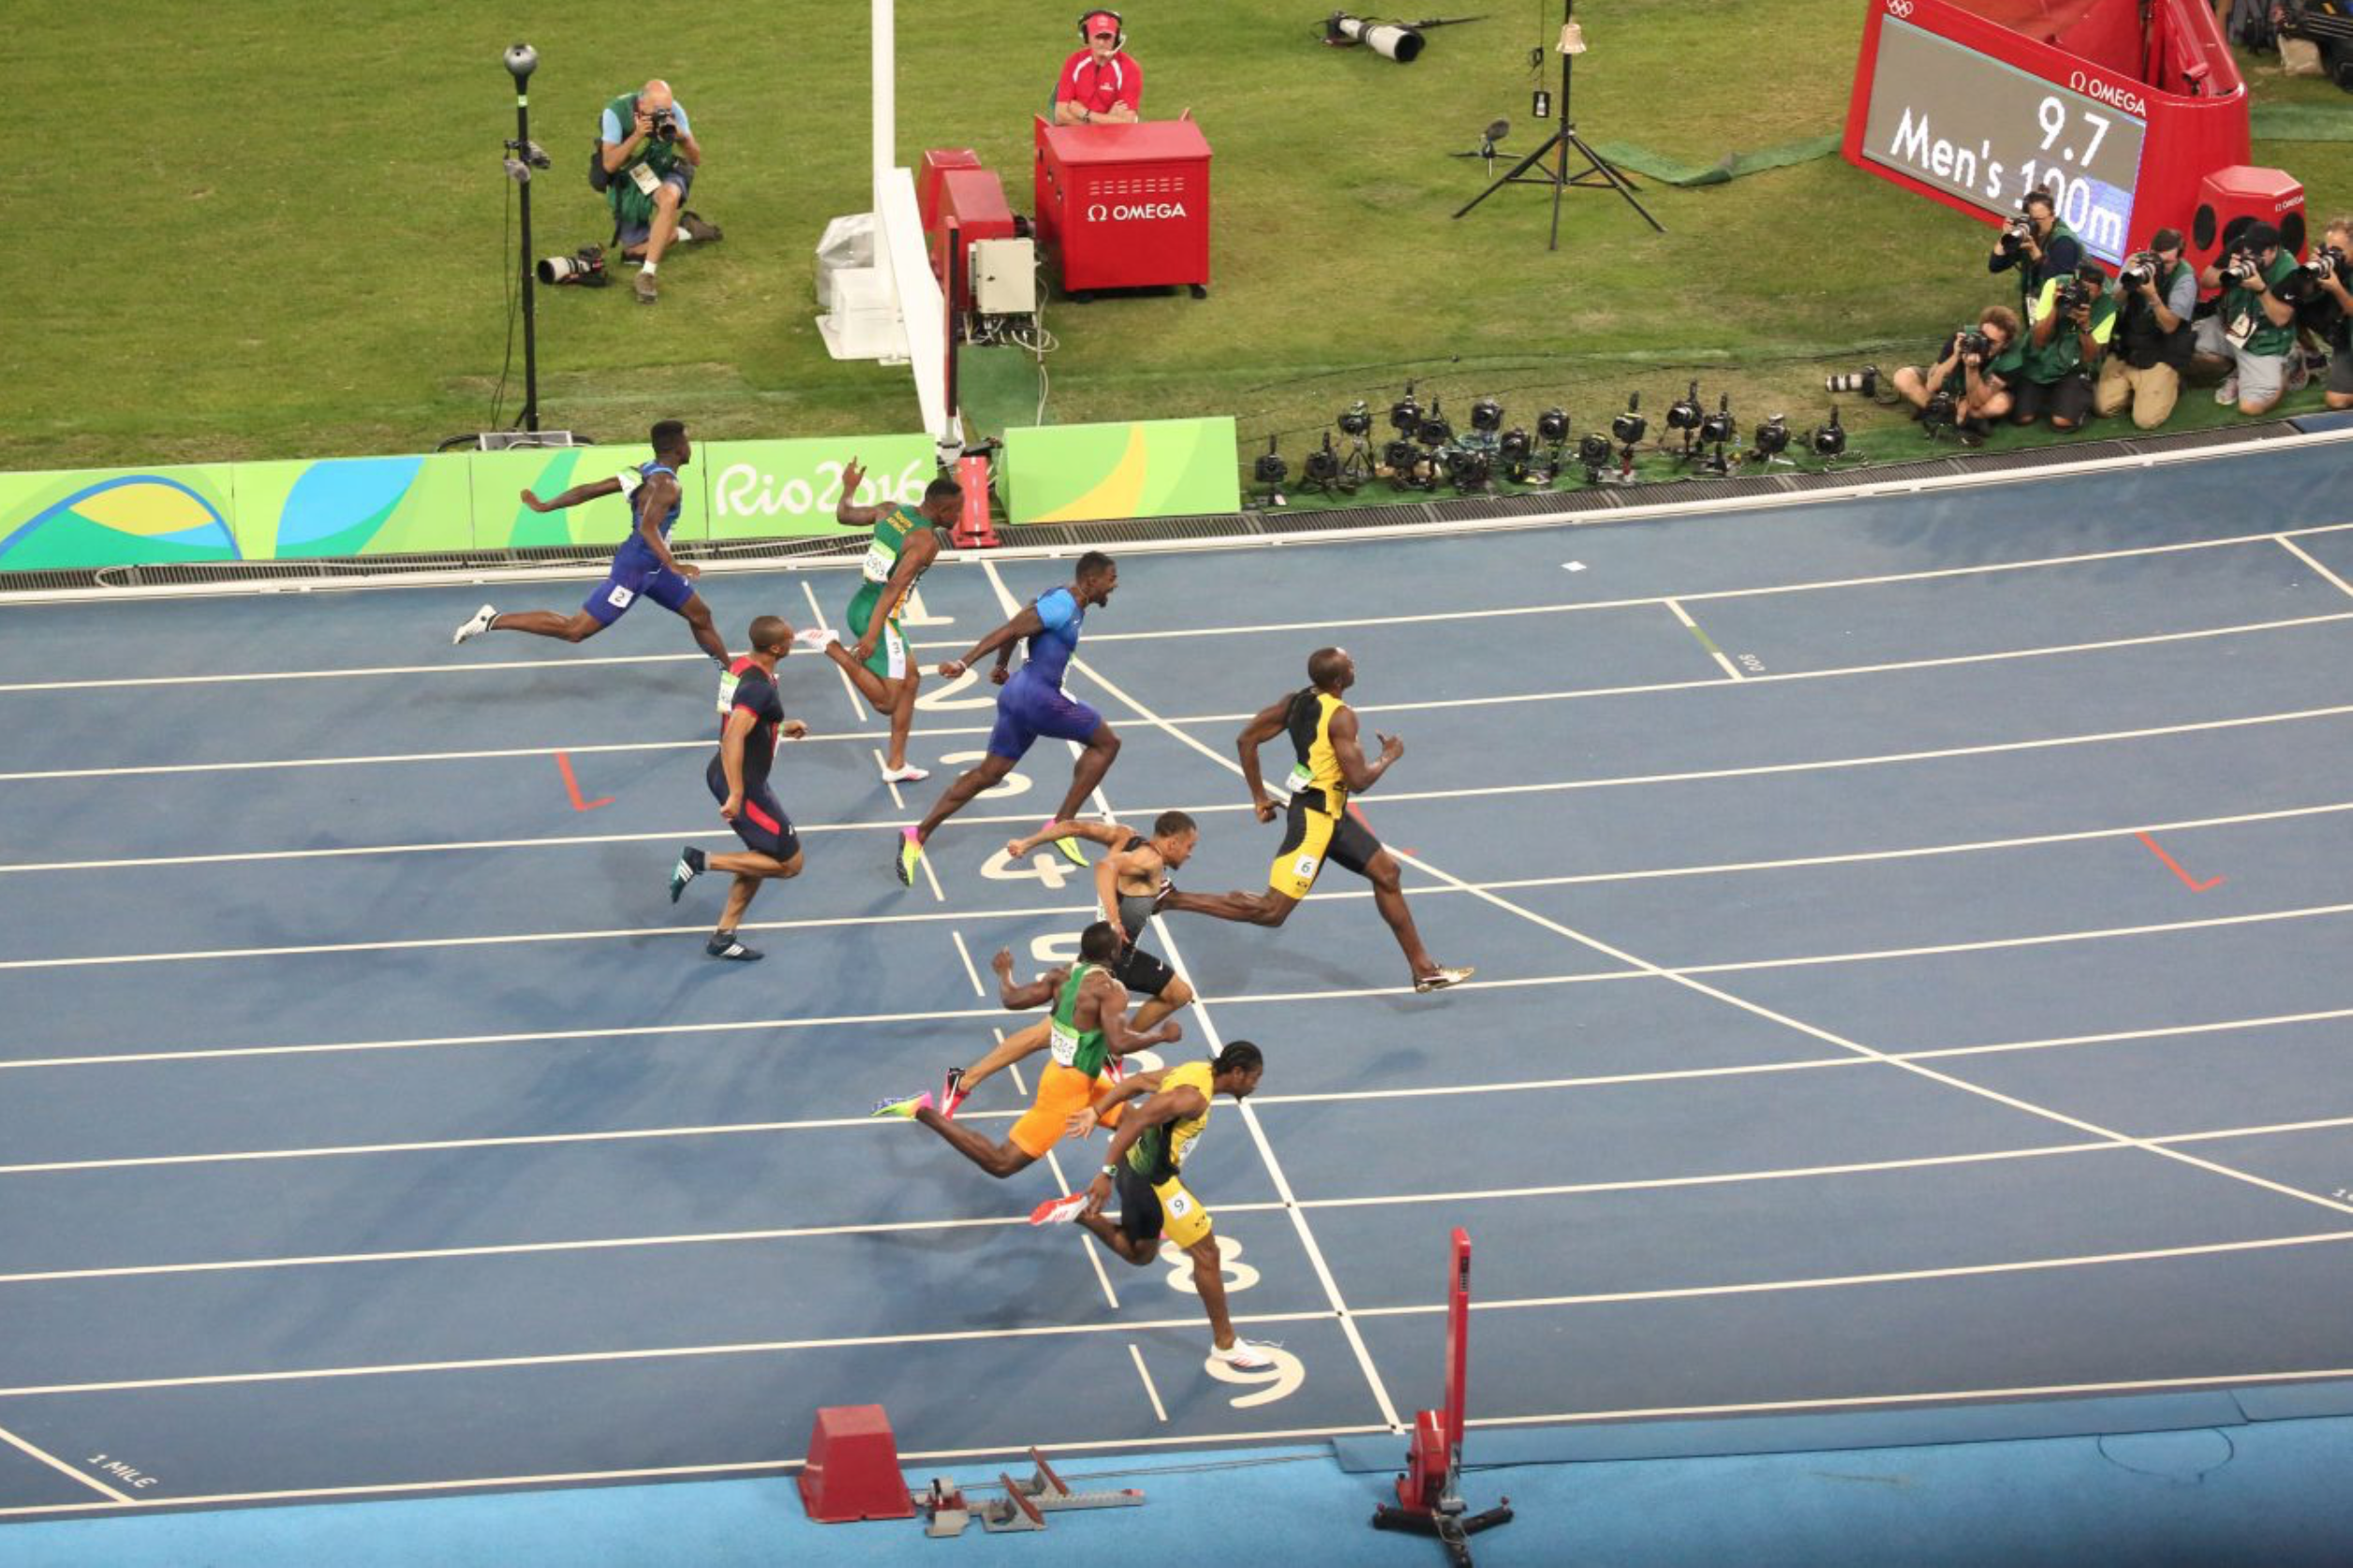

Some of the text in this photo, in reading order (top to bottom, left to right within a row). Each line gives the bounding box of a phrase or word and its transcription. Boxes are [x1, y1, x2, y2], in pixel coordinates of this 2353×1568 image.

[2089, 79, 2147, 117] OMEGA
[2038, 96, 2110, 167] 9.7
[1890, 107, 2004, 200] Men's
[1113, 202, 1186, 221] OMEGA
[614, 590, 626, 602] 2
[914, 664, 997, 711] 2
[981, 847, 1076, 889] 4
[1301, 862, 1311, 873] 6
[1174, 1199, 1184, 1212] 9
[1160, 1235, 1261, 1294] 8
[1205, 1345, 1305, 1409] 9
[86, 1454, 158, 1488] 1 MILE
